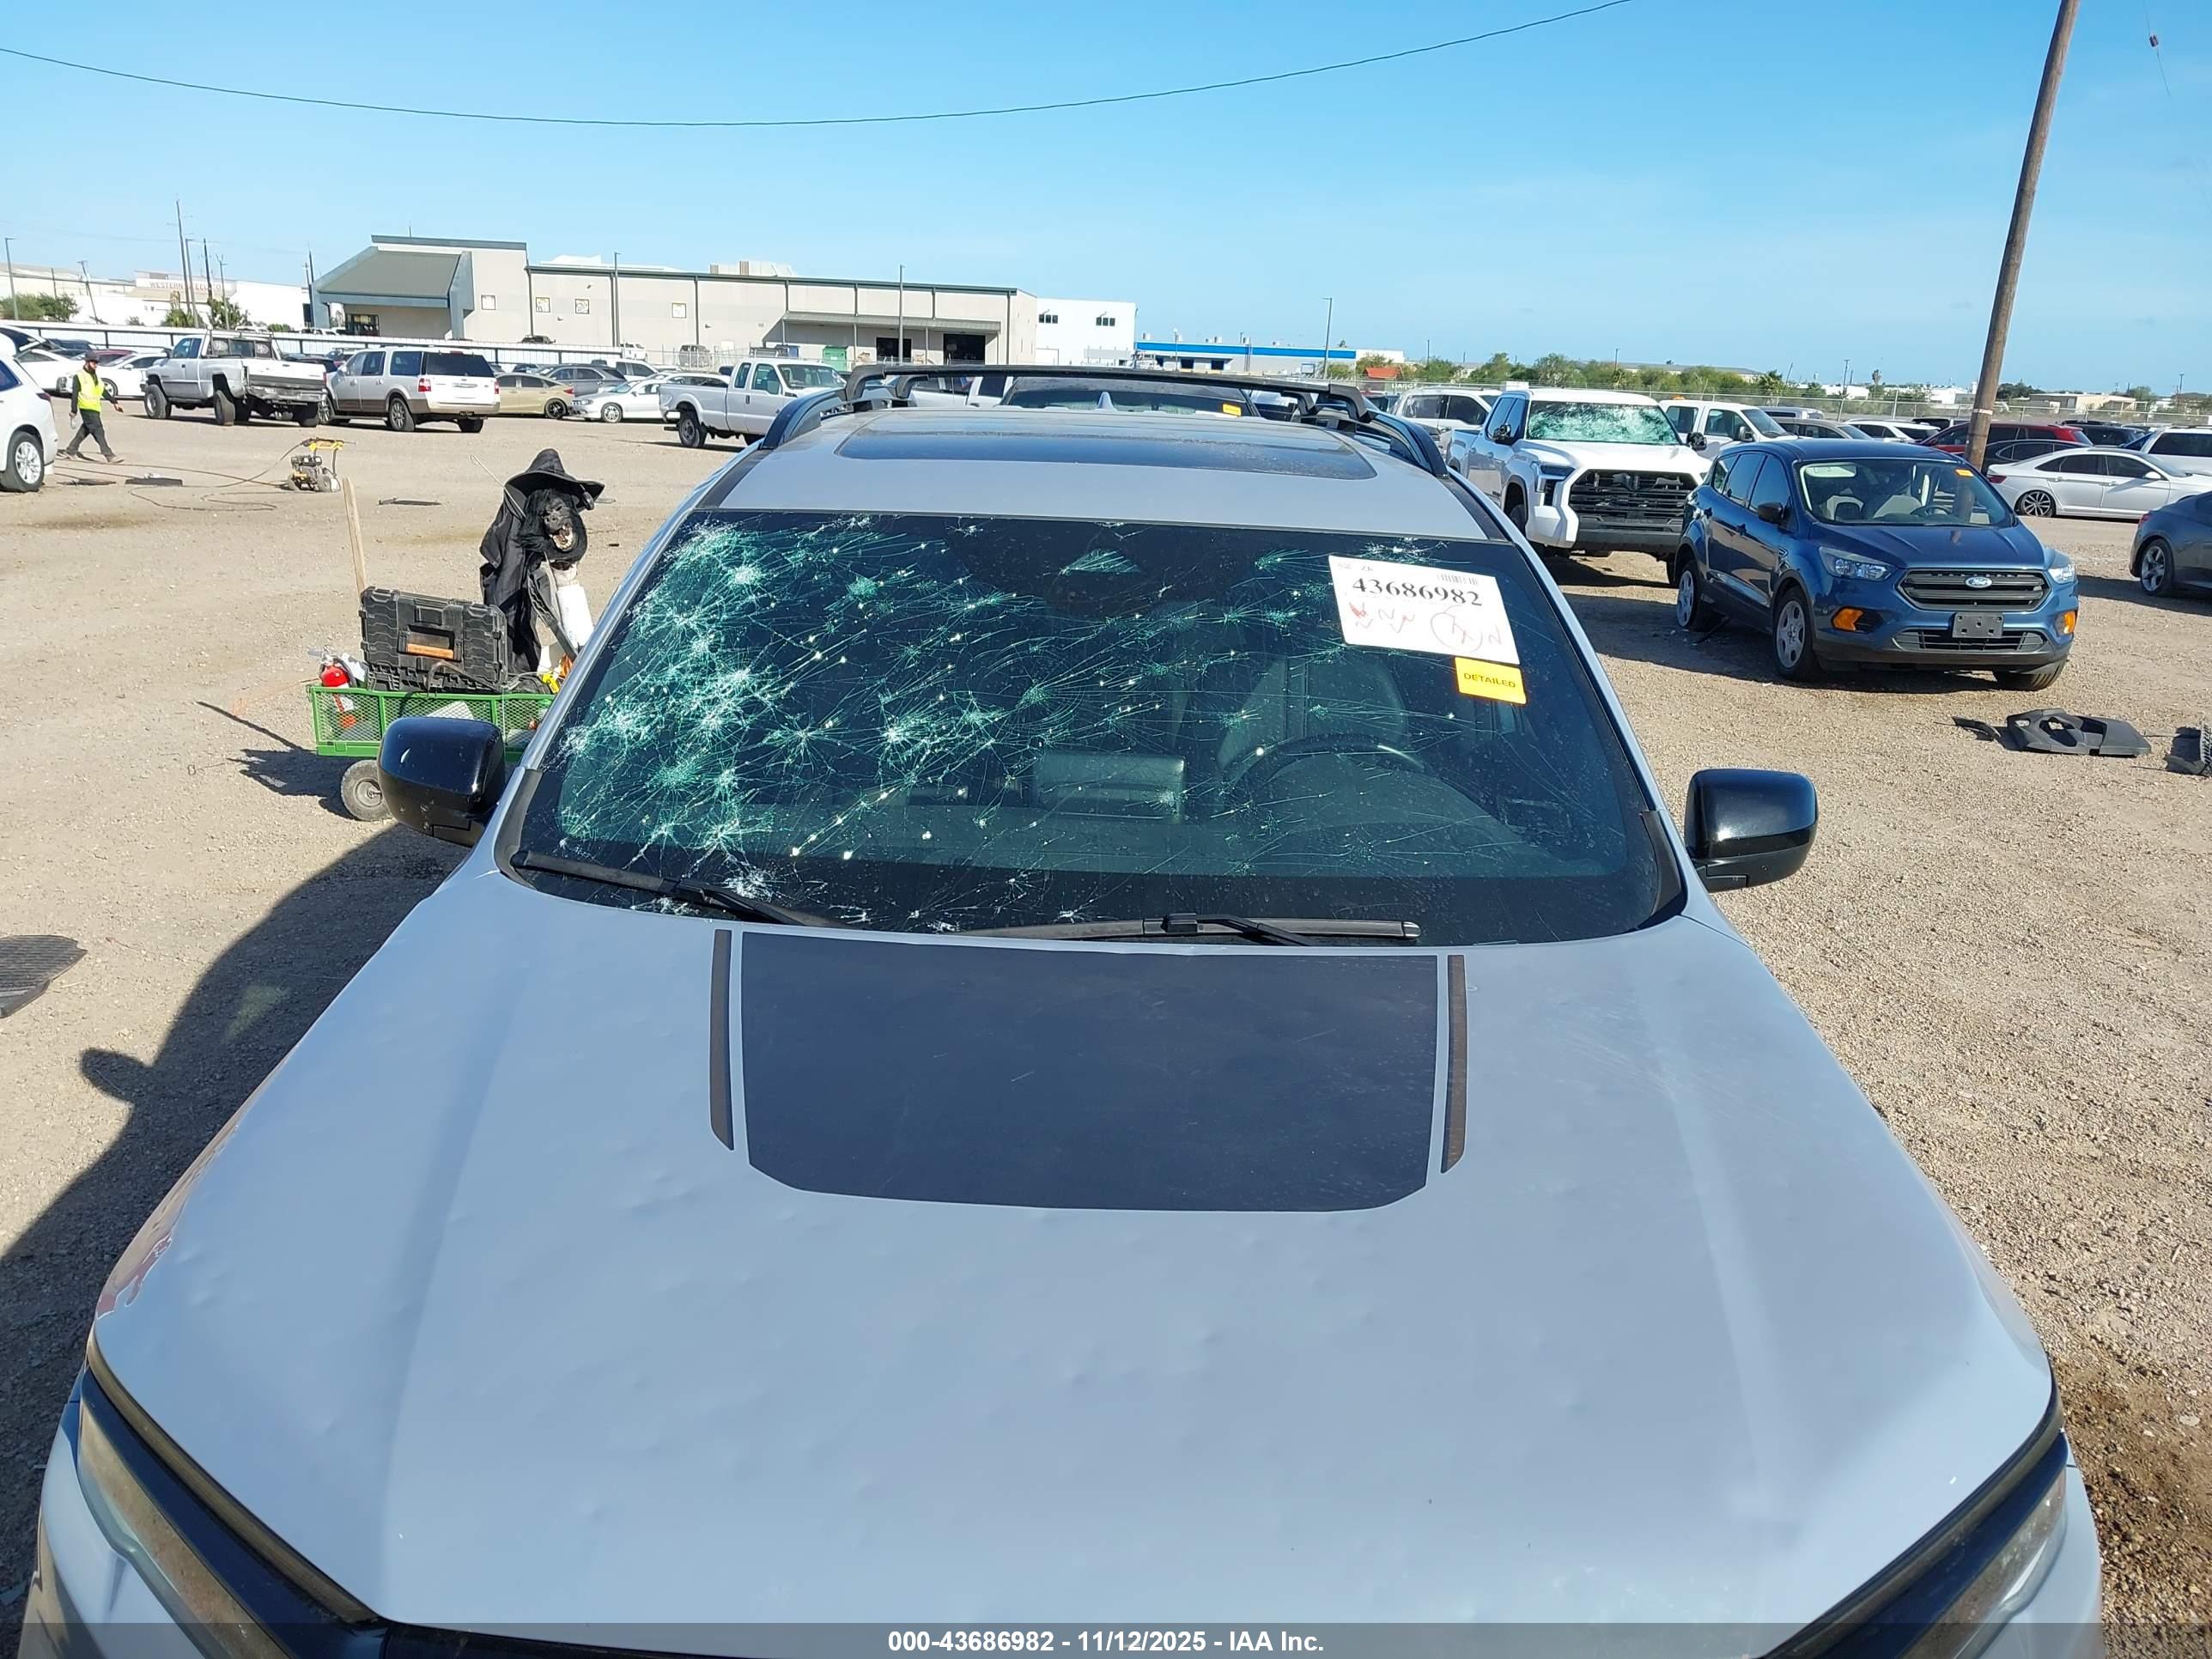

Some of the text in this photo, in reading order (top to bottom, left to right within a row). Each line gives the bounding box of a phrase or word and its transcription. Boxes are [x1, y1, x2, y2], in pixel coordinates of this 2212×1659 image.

[149, 282, 183, 290] WESTERN
[1352, 577, 1482, 606] 43686982
[1463, 672, 1516, 688] DETAILED
